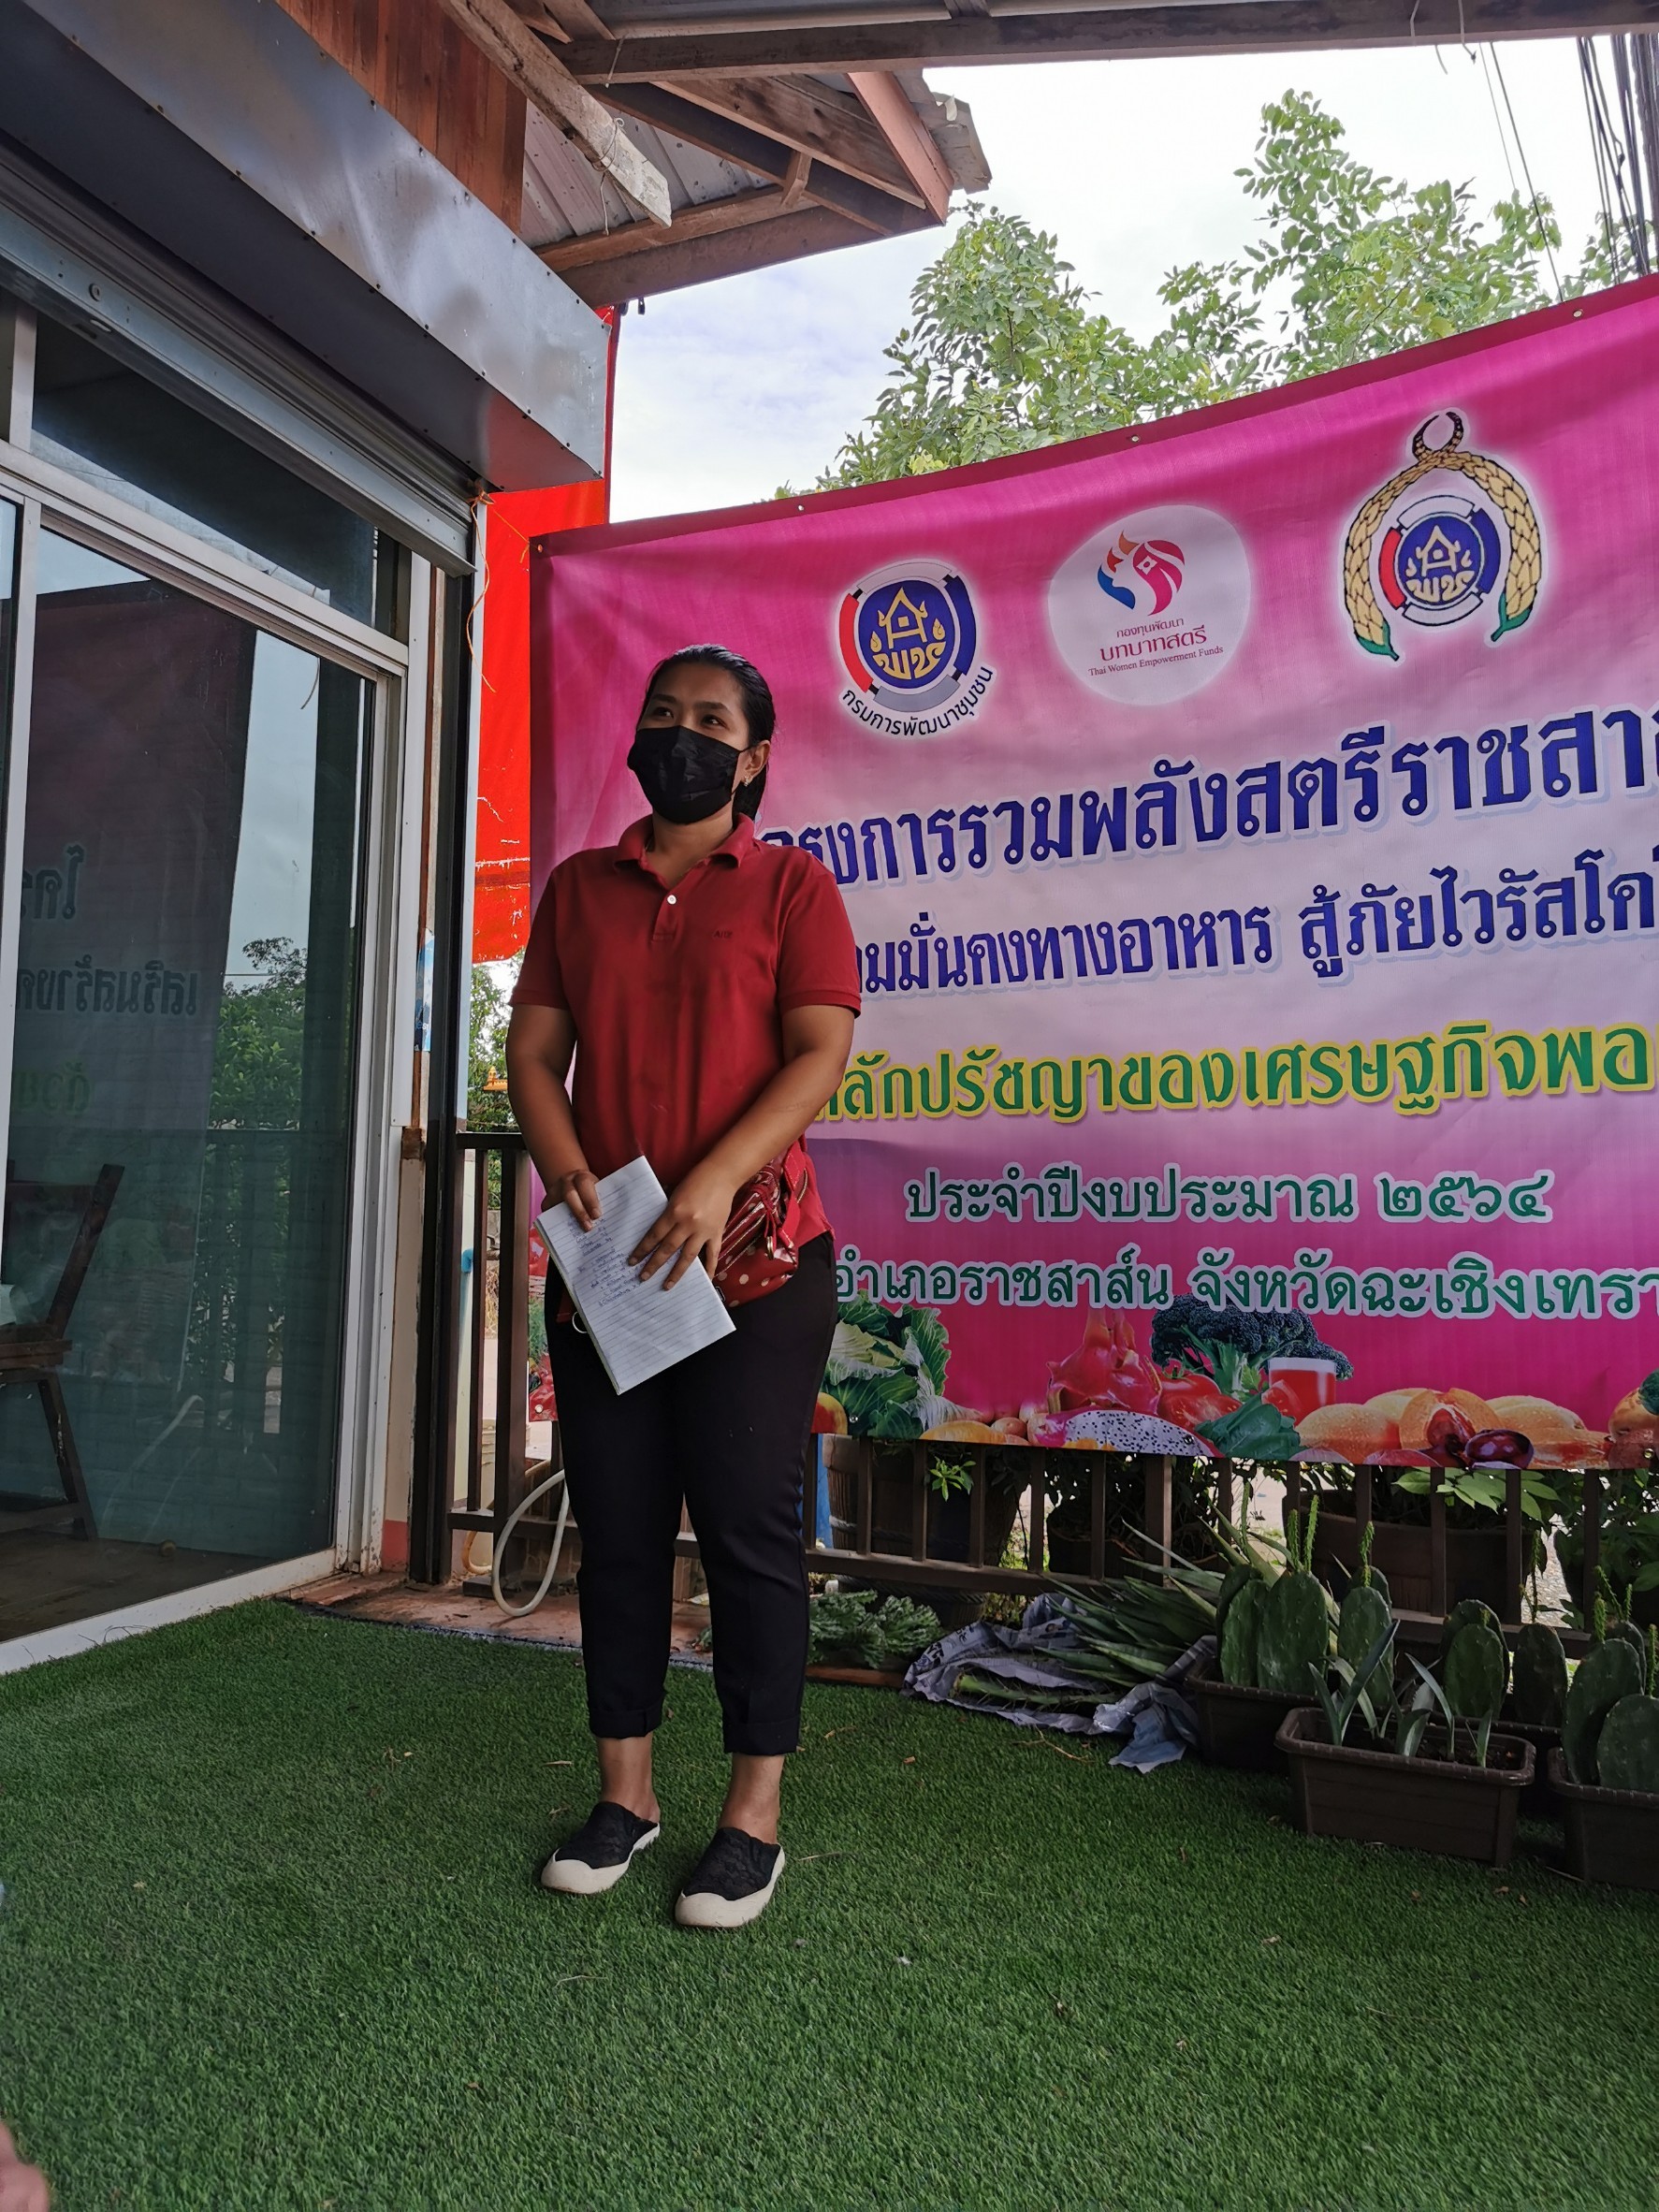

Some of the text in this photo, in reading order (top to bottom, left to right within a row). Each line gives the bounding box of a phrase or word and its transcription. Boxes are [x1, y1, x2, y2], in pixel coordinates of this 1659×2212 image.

[1099, 624, 1207, 662] บทบาทสตรี
[1116, 618, 1185, 638] กองทุนพัฒนา
[1088, 646, 1224, 677] Thai Women Empowerment Funds
[842, 665, 994, 736] กรมการพัฒนาชุมชน
[761, 709, 1659, 885] รงการรวมพลังสตรีราชสา
[855, 845, 1659, 994] มมั่นคงทางอาหาร สู้ภัยไวรัสโค
[817, 1025, 1649, 1117] ลักปรัชญาของเศรษฐกิจพอ
[908, 1166, 1549, 1217] ประจำปีงบประมาณ ๒๕๖๔
[837, 1248, 1169, 1304] อำเภอราชสาส์น
